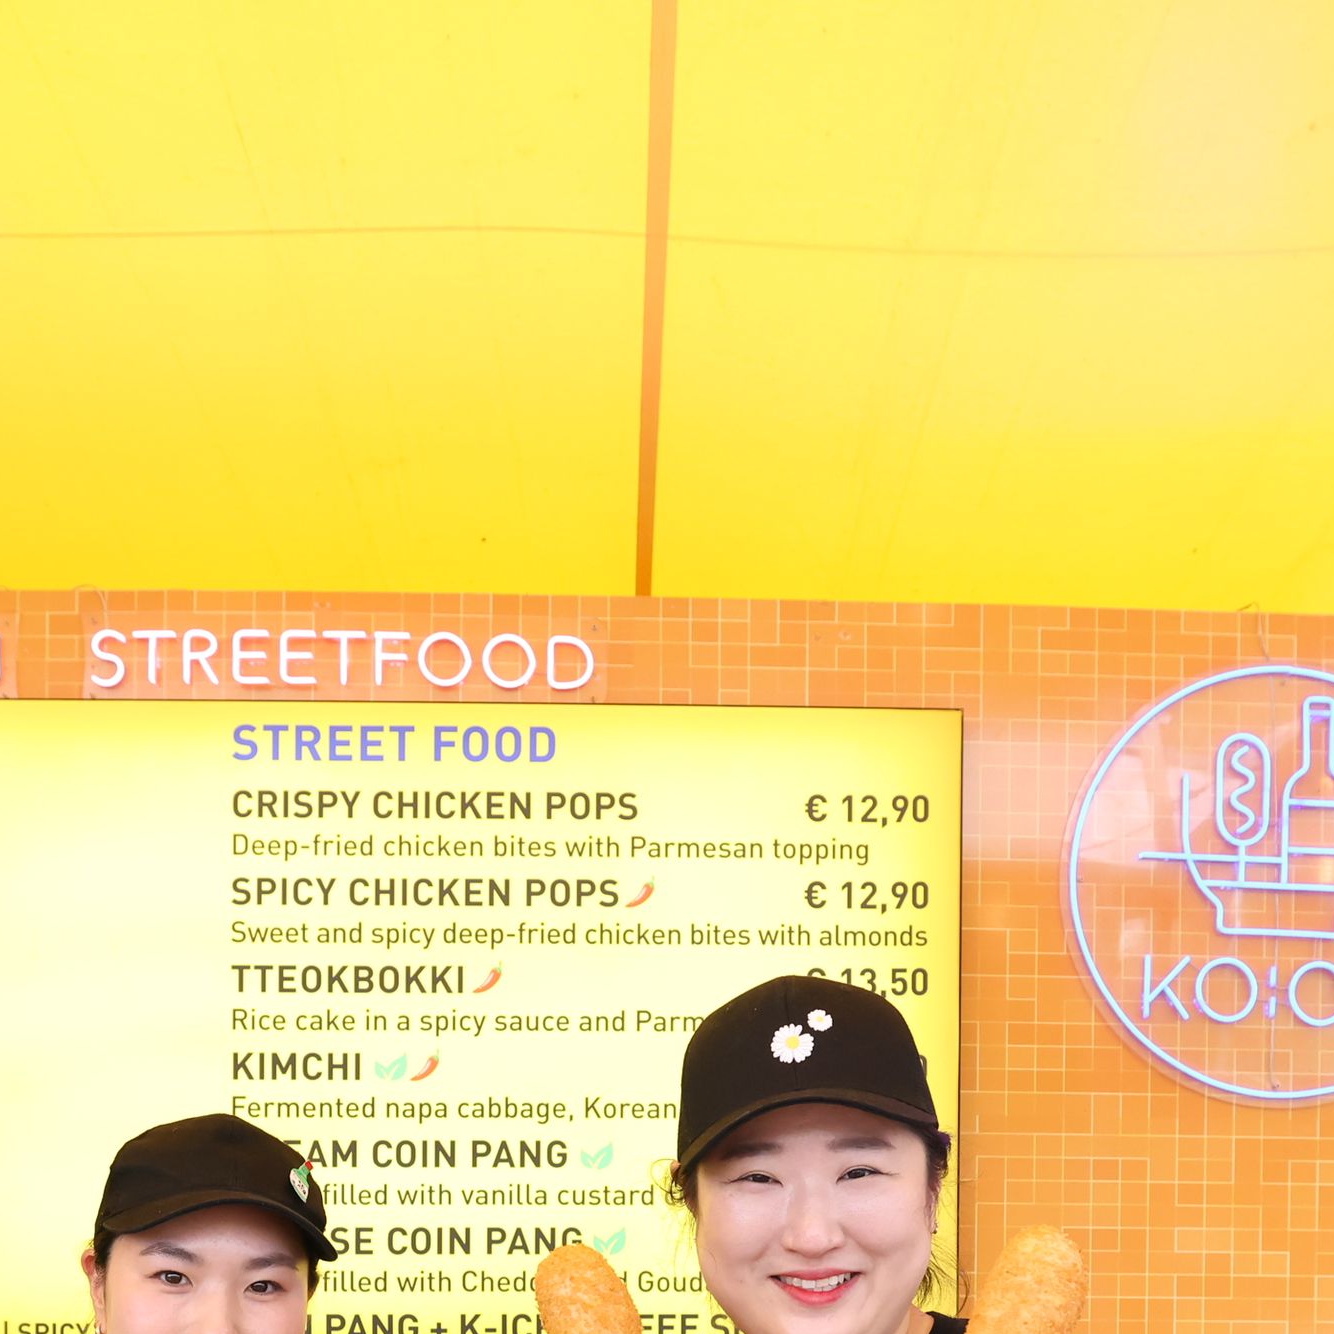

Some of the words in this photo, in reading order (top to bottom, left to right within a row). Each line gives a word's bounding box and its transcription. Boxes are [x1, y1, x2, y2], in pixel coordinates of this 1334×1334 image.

[89, 629, 597, 691] STREETFOOD
[233, 724, 415, 761] STREET
[434, 726, 555, 762] FOOD
[233, 791, 360, 818] CRISPY
[373, 791, 531, 819] CHICKEN
[547, 792, 637, 820] POPS
[805, 795, 827, 822] €
[842, 795, 929, 827] 12,90
[233, 834, 372, 861] Deep-fried
[384, 835, 482, 856] chicken
[495, 835, 556, 857] bites
[566, 836, 619, 857] with
[631, 836, 762, 858] Parmesan
[773, 838, 868, 865] topping
[232, 878, 335, 905] SPICY
[350, 878, 509, 906] CHICKEN
[526, 879, 618, 907] POPS
[805, 881, 826, 908] €
[842, 882, 928, 914] 12,90
[232, 921, 308, 943] Sweet
[317, 922, 361, 943] and
[372, 922, 435, 949] spicy
[444, 922, 575, 950] deep-fried
[586, 923, 680, 944] chicken
[691, 924, 750, 945] bites
[759, 925, 810, 945] with
[820, 925, 927, 946] almonds
[232, 965, 463, 993] TTEOKBOKKI
[233, 1009, 285, 1030] Rice
[296, 1009, 355, 1030] cake
[366, 1009, 386, 1030] in
[397, 1016, 409, 1030] a
[420, 1009, 485, 1037] spicy
[495, 1016, 569, 1031] sauce
[580, 1010, 624, 1031] and
[636, 1010, 704, 1031] Parm
[233, 1053, 360, 1080] KIMCHI
[233, 1096, 374, 1118] Fermented
[387, 1103, 447, 1124] napa
[458, 1097, 573, 1124] cabbage,
[585, 1097, 676, 1118] Korean
[373, 1140, 455, 1167] COIN
[472, 1140, 567, 1168] PANG
[323, 1184, 387, 1205] filled
[397, 1184, 451, 1205] with
[462, 1184, 546, 1205] vanilla
[558, 1185, 653, 1205] custard
[388, 1227, 470, 1255] COIN
[323, 1271, 387, 1292] filled
[397, 1271, 451, 1292] with
[462, 1270, 536, 1293] Ched
[639, 1271, 702, 1292] Goud
